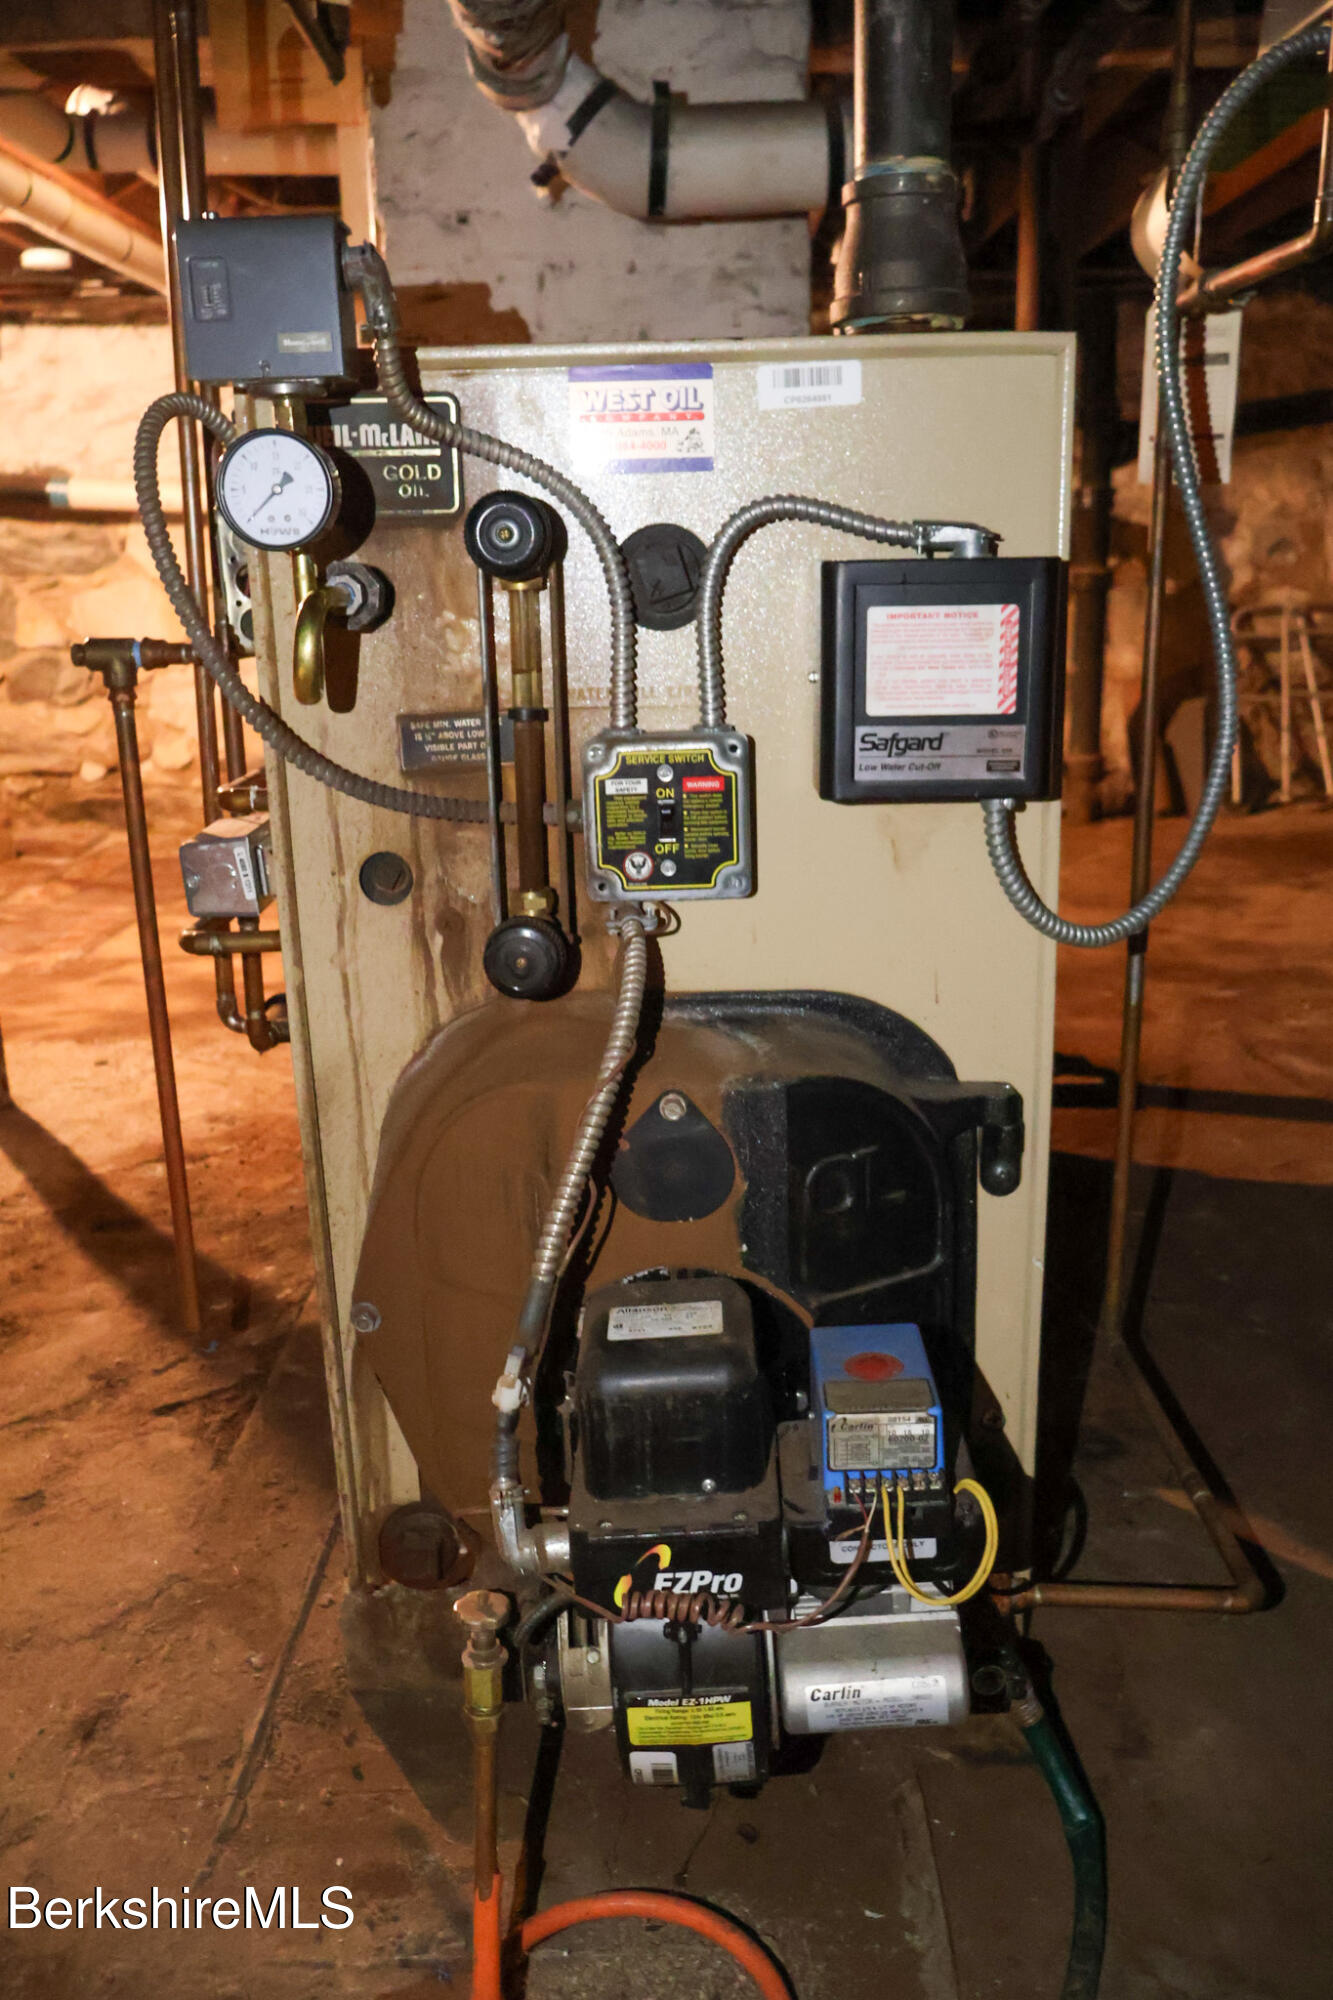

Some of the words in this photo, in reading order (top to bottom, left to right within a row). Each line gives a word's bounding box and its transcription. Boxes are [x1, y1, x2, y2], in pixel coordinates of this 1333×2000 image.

[579, 388, 656, 412] WEST
[662, 386, 704, 411] OIL
[661, 427, 679, 436] MA
[383, 464, 442, 481] GOLD
[398, 483, 430, 498] OIL
[886, 612, 941, 620] IMPORTANT
[943, 611, 979, 619] NOTICE
[453, 719, 481, 728] WATER
[438, 731, 465, 740] ABOVE
[424, 743, 455, 752] VISIBLE
[457, 741, 478, 750] PART
[859, 732, 944, 757] Safgard
[461, 752, 487, 760] GLASS
[625, 754, 665, 765] SERVICE
[668, 754, 705, 764] SWITCH
[858, 763, 877, 771] Low
[880, 763, 906, 771] Water
[908, 762, 941, 771] Cut-Off
[686, 780, 720, 788] WARNING
[656, 787, 675, 798] ON
[654, 843, 680, 854] OFF
[840, 1422, 874, 1432] Carlin
[654, 1570, 744, 1594] EZPro
[810, 1686, 861, 1702] Carlin
[648, 1699, 680, 1707] Model
[681, 1695, 732, 1706] EZ-1HPW
